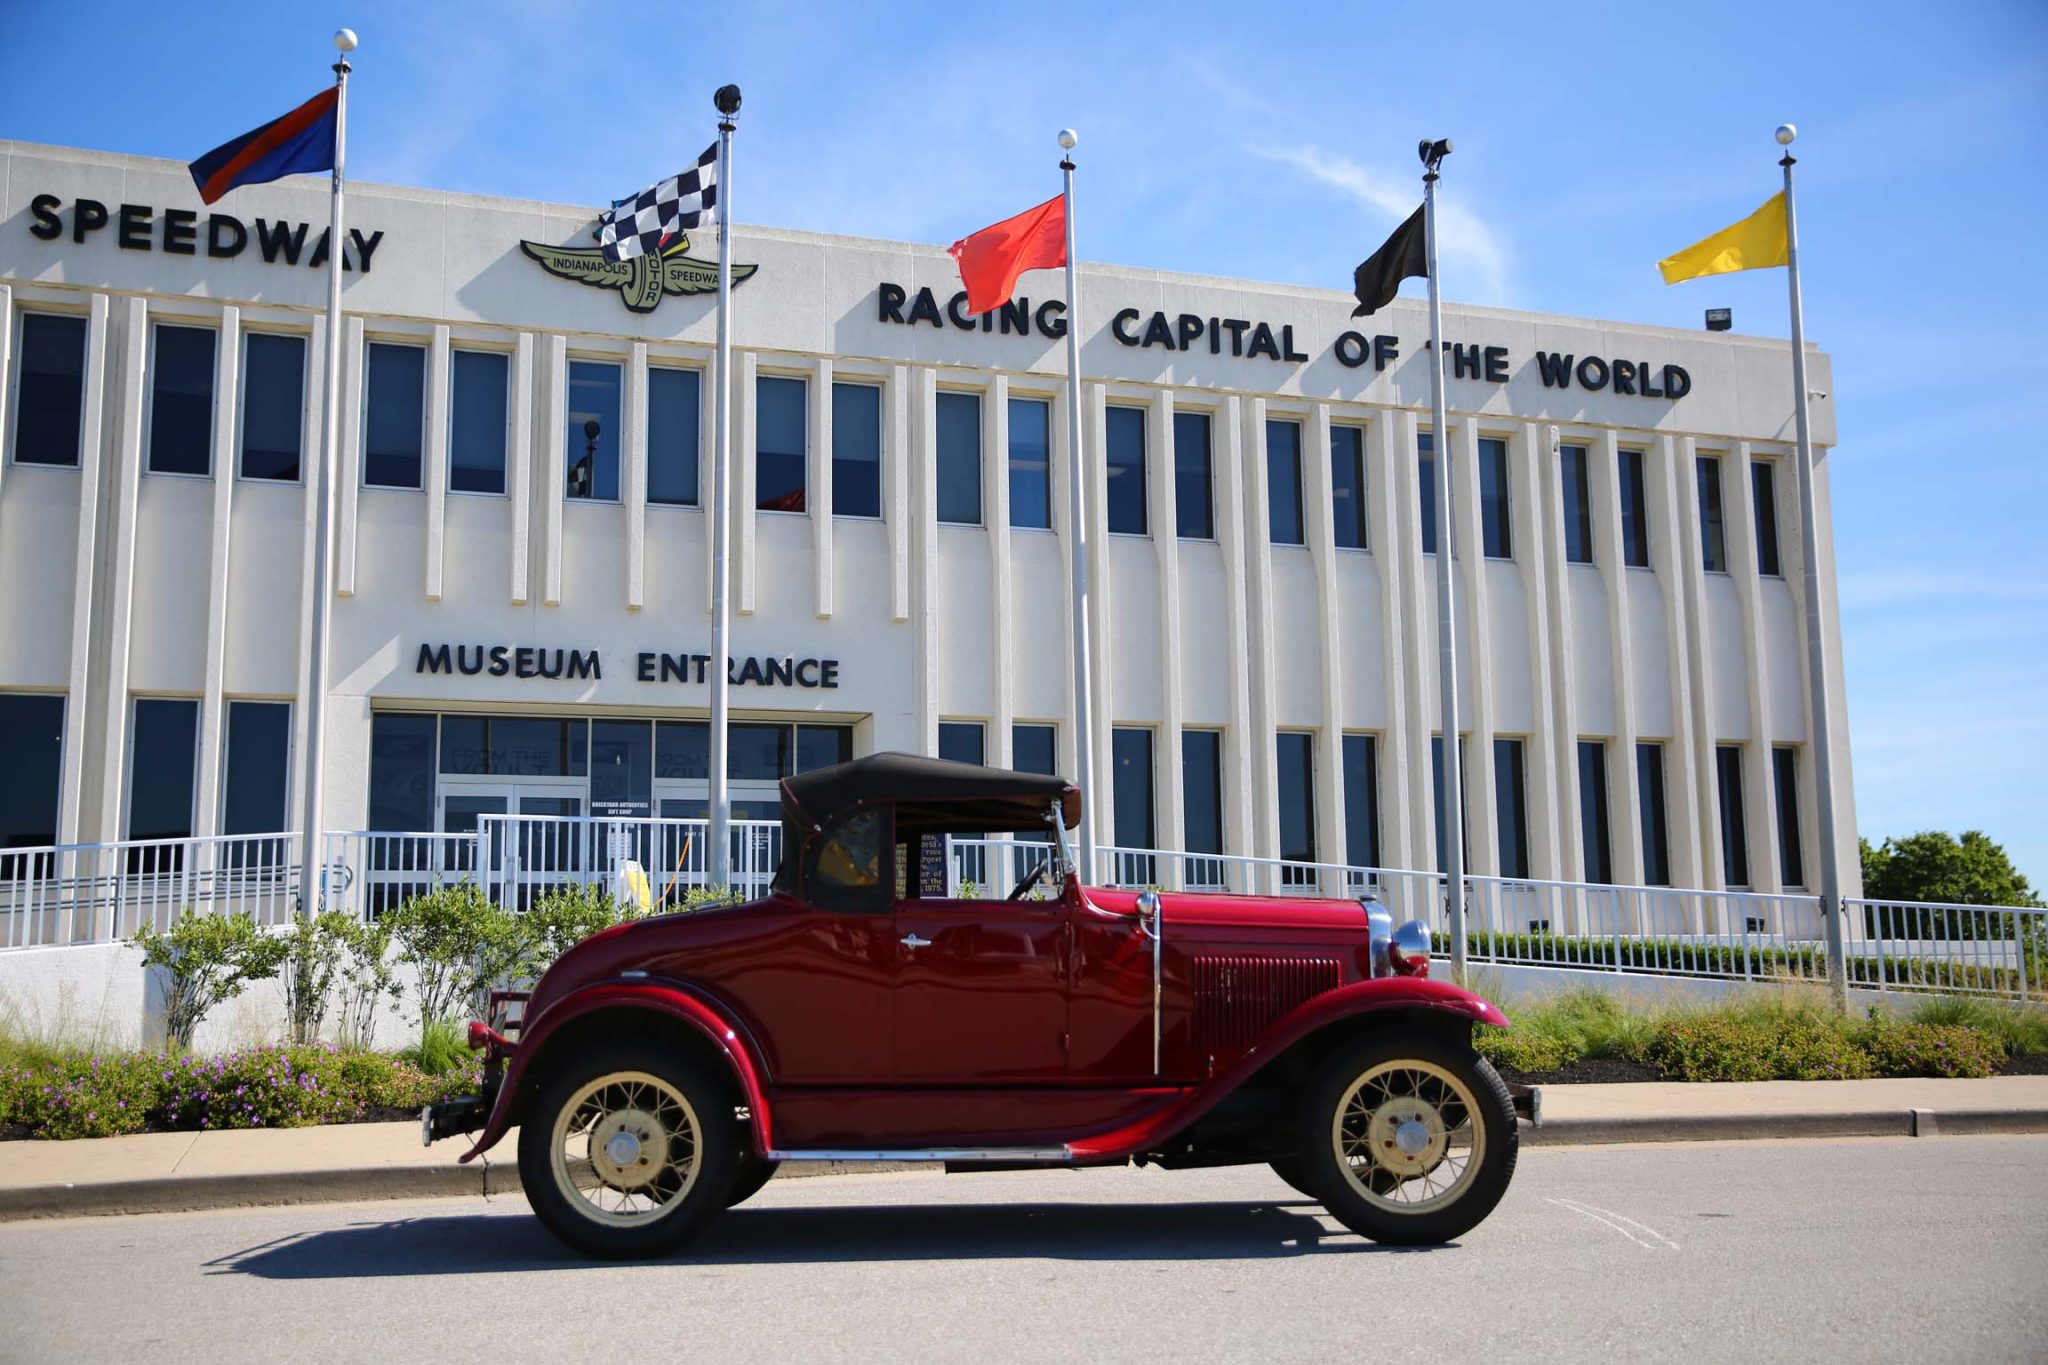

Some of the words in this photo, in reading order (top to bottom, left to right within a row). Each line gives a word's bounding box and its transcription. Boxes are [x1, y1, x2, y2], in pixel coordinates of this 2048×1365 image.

[30, 194, 384, 273] SPEEDWAY
[553, 257, 628, 276] INDIANAPOLIS
[646, 251, 658, 301] MOTOR
[670, 269, 719, 284] SPEEDWA
[878, 282, 1068, 339] RACING
[1112, 308, 1309, 362] CAPITAL
[1335, 331, 1398, 371] OF
[1425, 340, 1509, 383] THE
[1536, 351, 1691, 399] WORLD
[416, 643, 601, 680] MUSEUM
[638, 652, 839, 688] ENTRANCE
